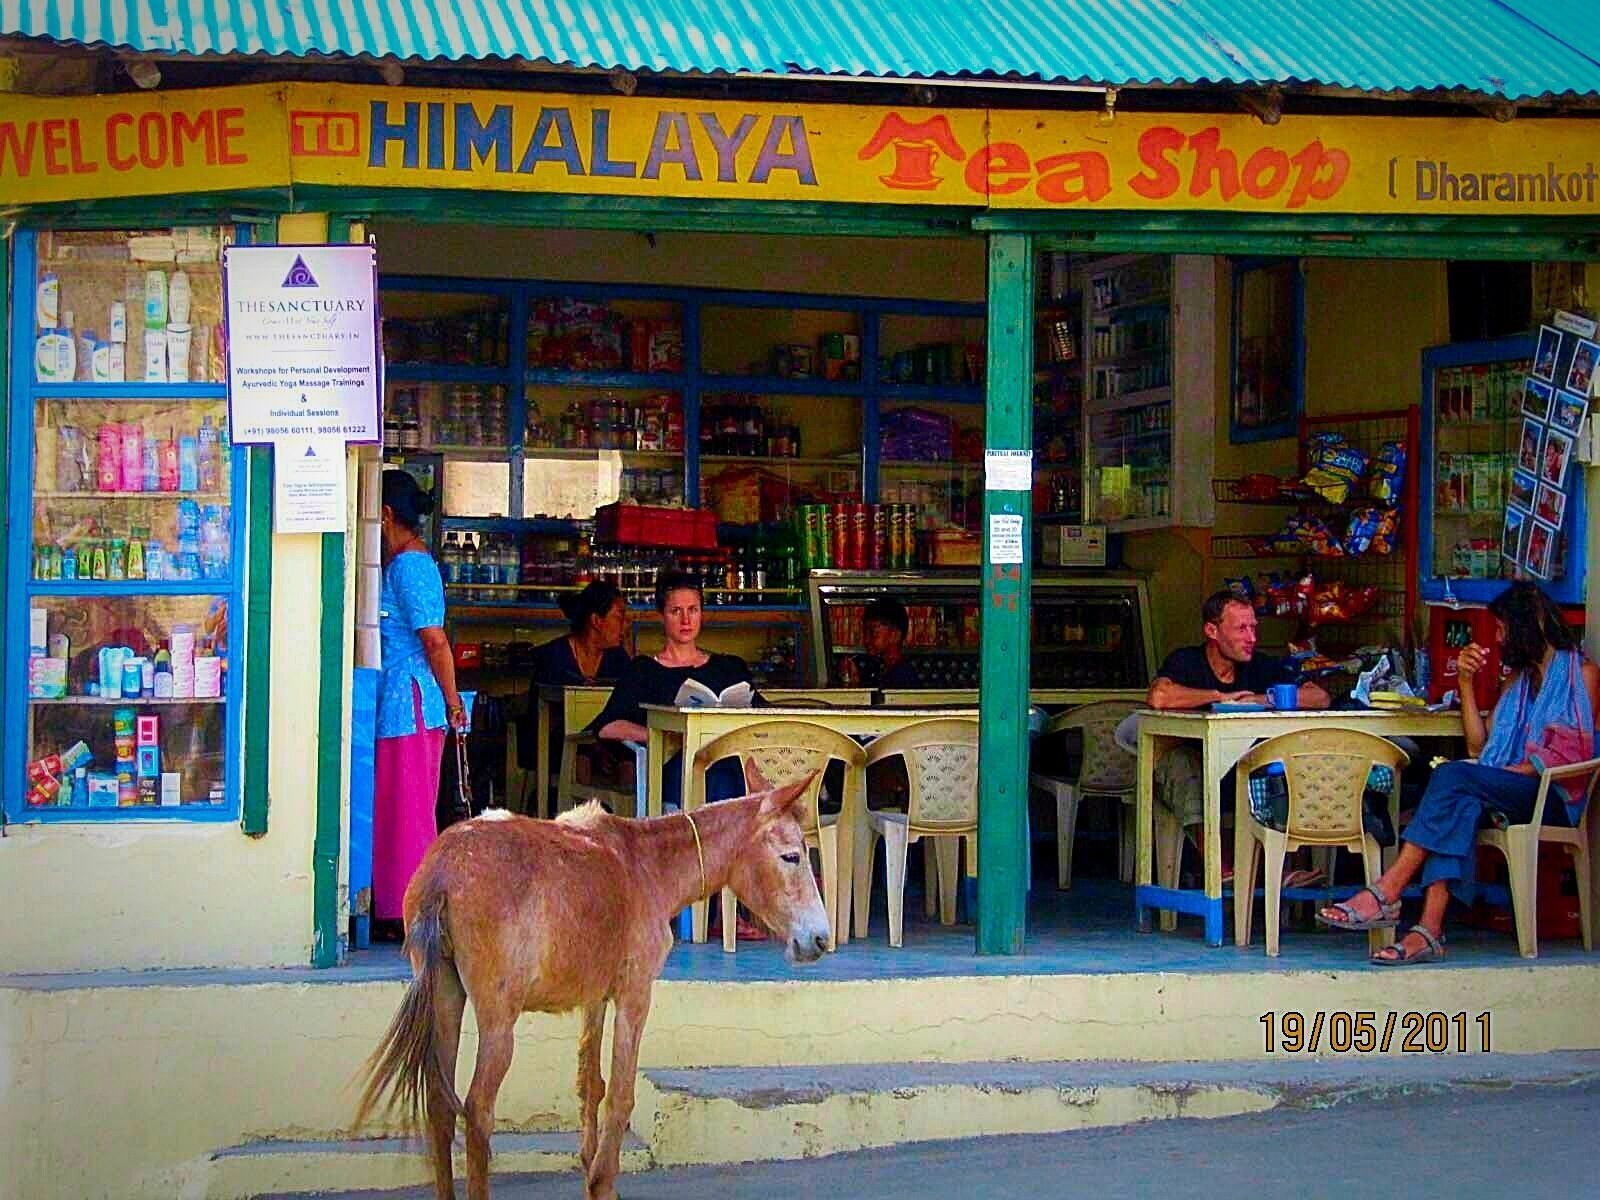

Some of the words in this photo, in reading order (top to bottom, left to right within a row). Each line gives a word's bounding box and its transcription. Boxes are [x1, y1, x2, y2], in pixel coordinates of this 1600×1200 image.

[0, 107, 249, 177] WELCOME
[291, 111, 360, 157] TO
[368, 101, 819, 186] HIMALAYA
[858, 111, 1112, 203] Tea
[1128, 125, 1351, 209] Shop
[235, 367, 277, 376] Workshops
[279, 366, 288, 374] for
[290, 366, 321, 374] Personal
[323, 365, 370, 375] Development
[242, 380, 278, 389] Ayurvedic
[280, 380, 297, 389] Yoga
[299, 379, 330, 389] Massage
[332, 378, 365, 387] Trainings
[300, 393, 308, 403] &
[270, 409, 305, 417] Individual
[306, 408, 339, 416] Sessions
[343, 425, 367, 433] 61222
